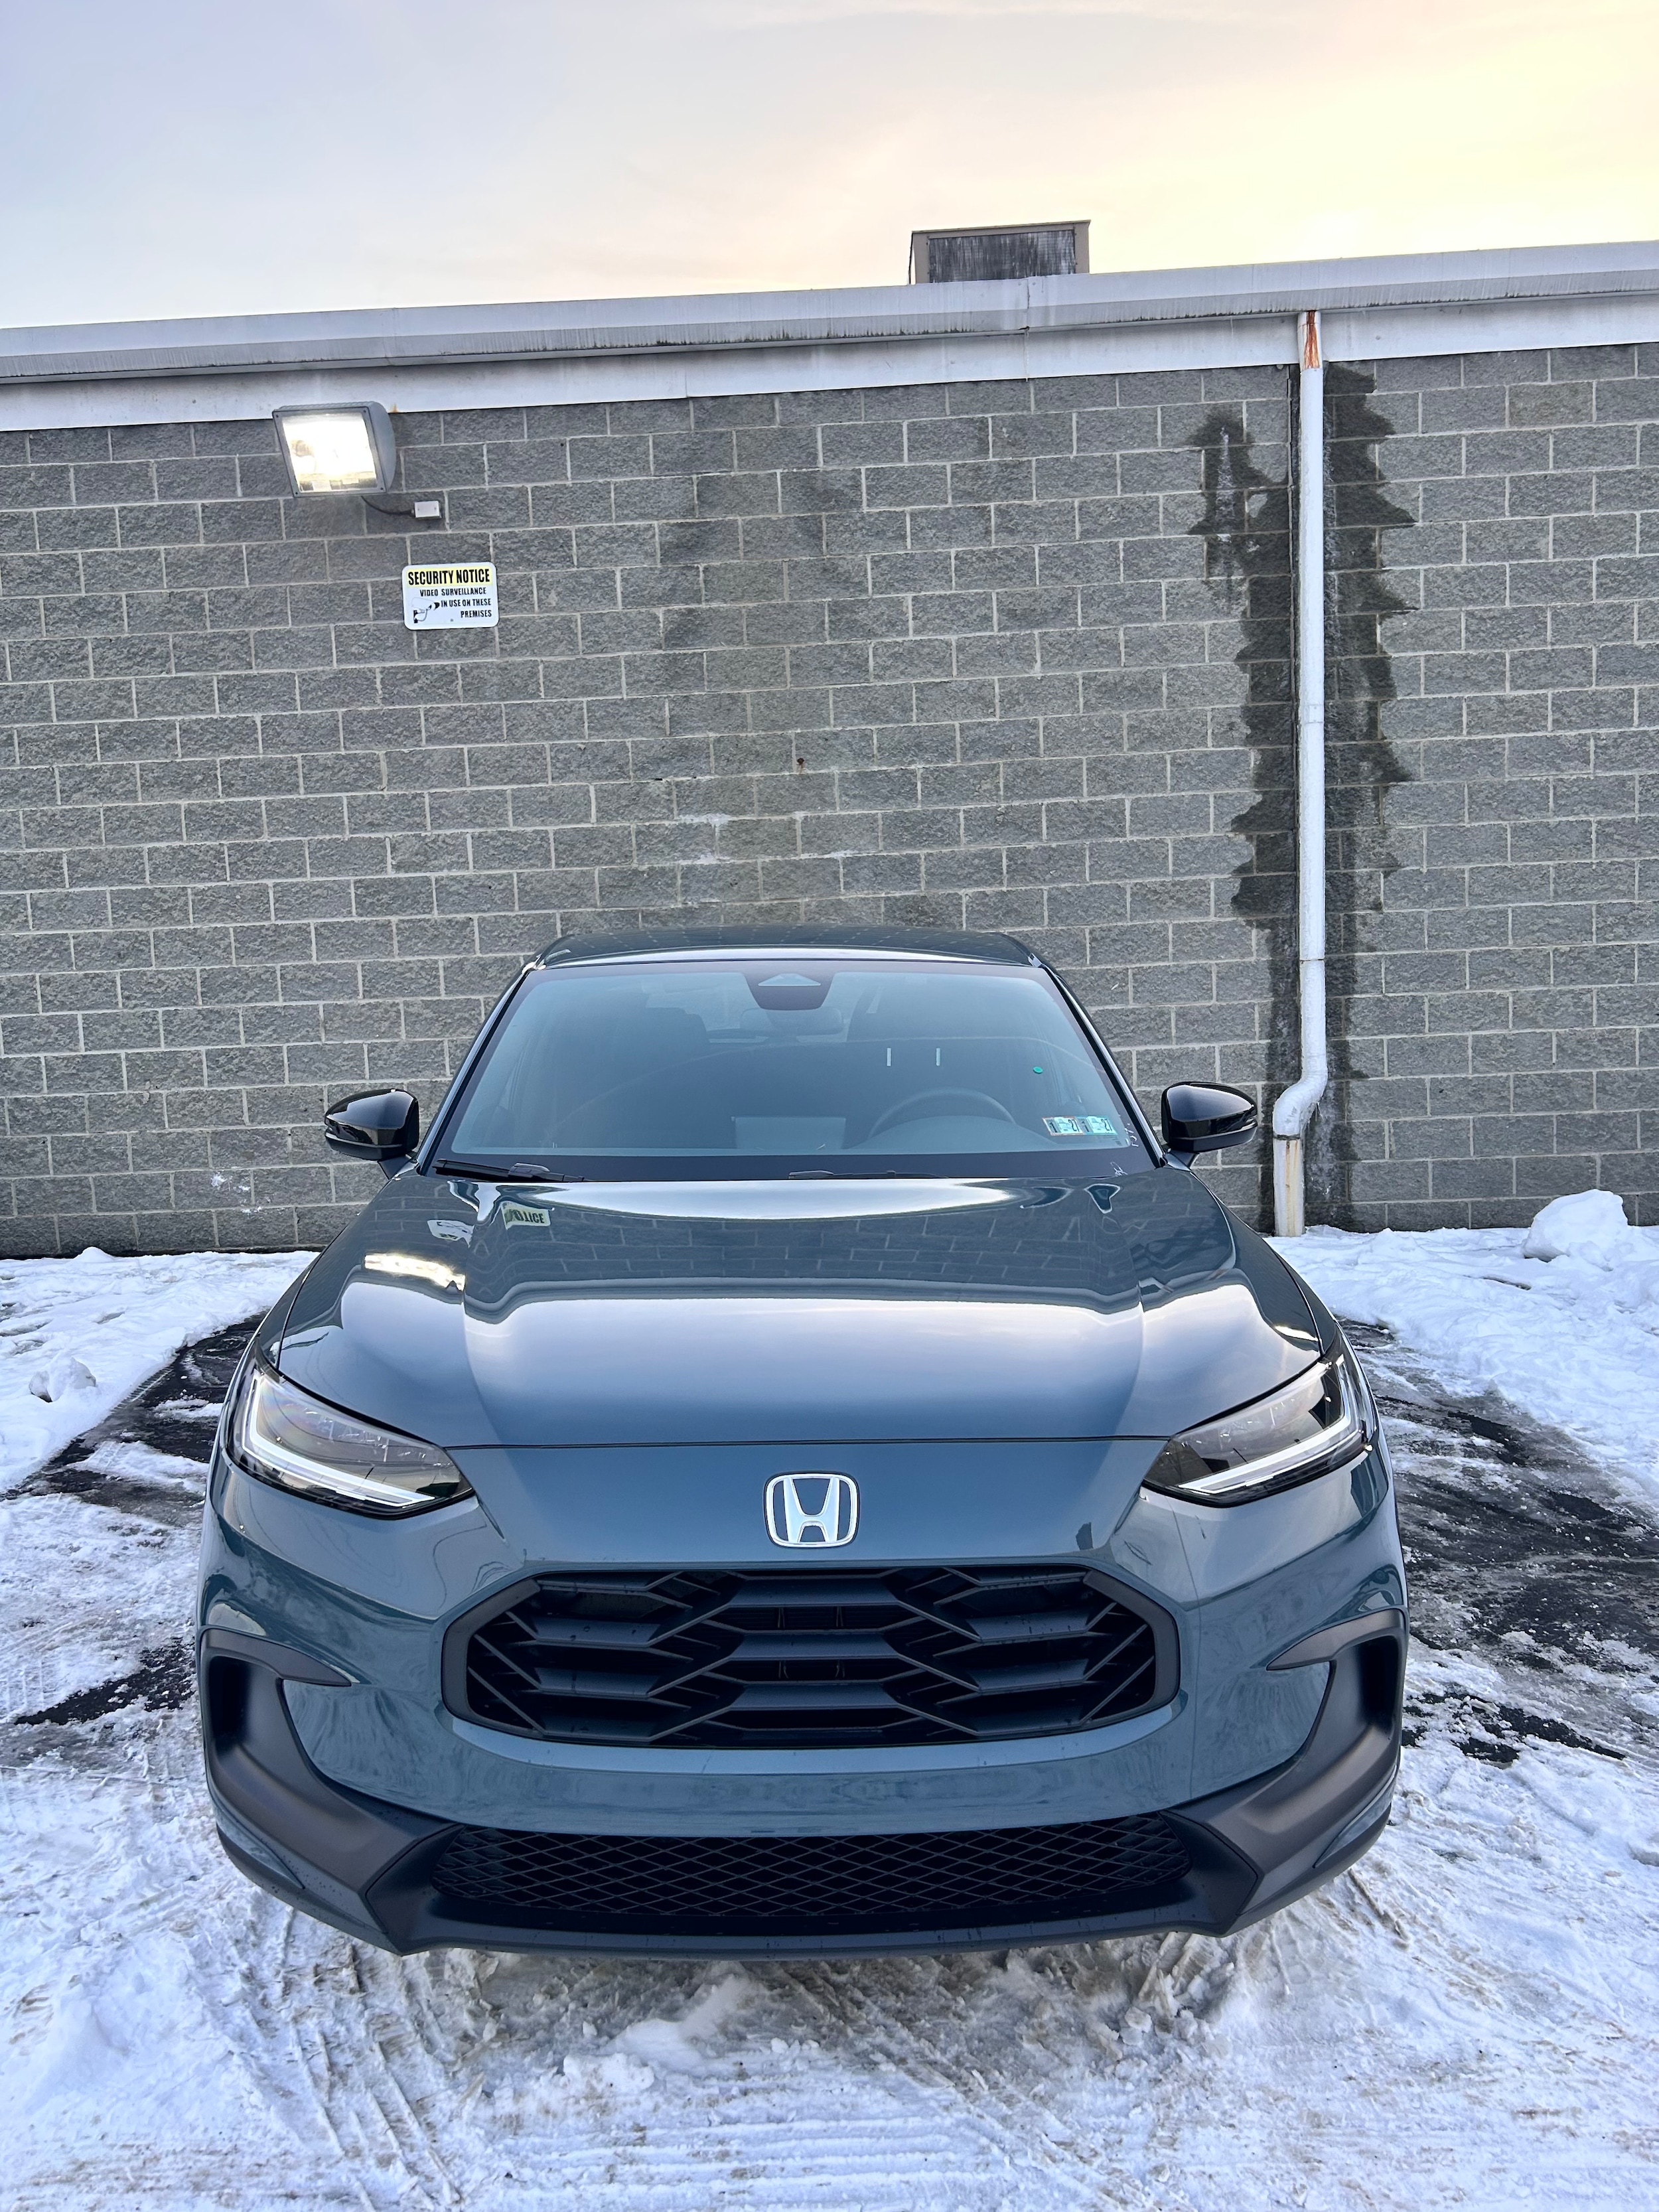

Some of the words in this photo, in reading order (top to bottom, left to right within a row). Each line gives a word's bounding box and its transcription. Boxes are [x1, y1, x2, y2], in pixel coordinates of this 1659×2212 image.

[408, 570, 454, 585] SECURITY
[456, 569, 490, 583] NOTICE
[441, 587, 486, 596] SURVEILLANCE
[472, 598, 491, 607] THESE
[461, 609, 492, 618] PREMISES
